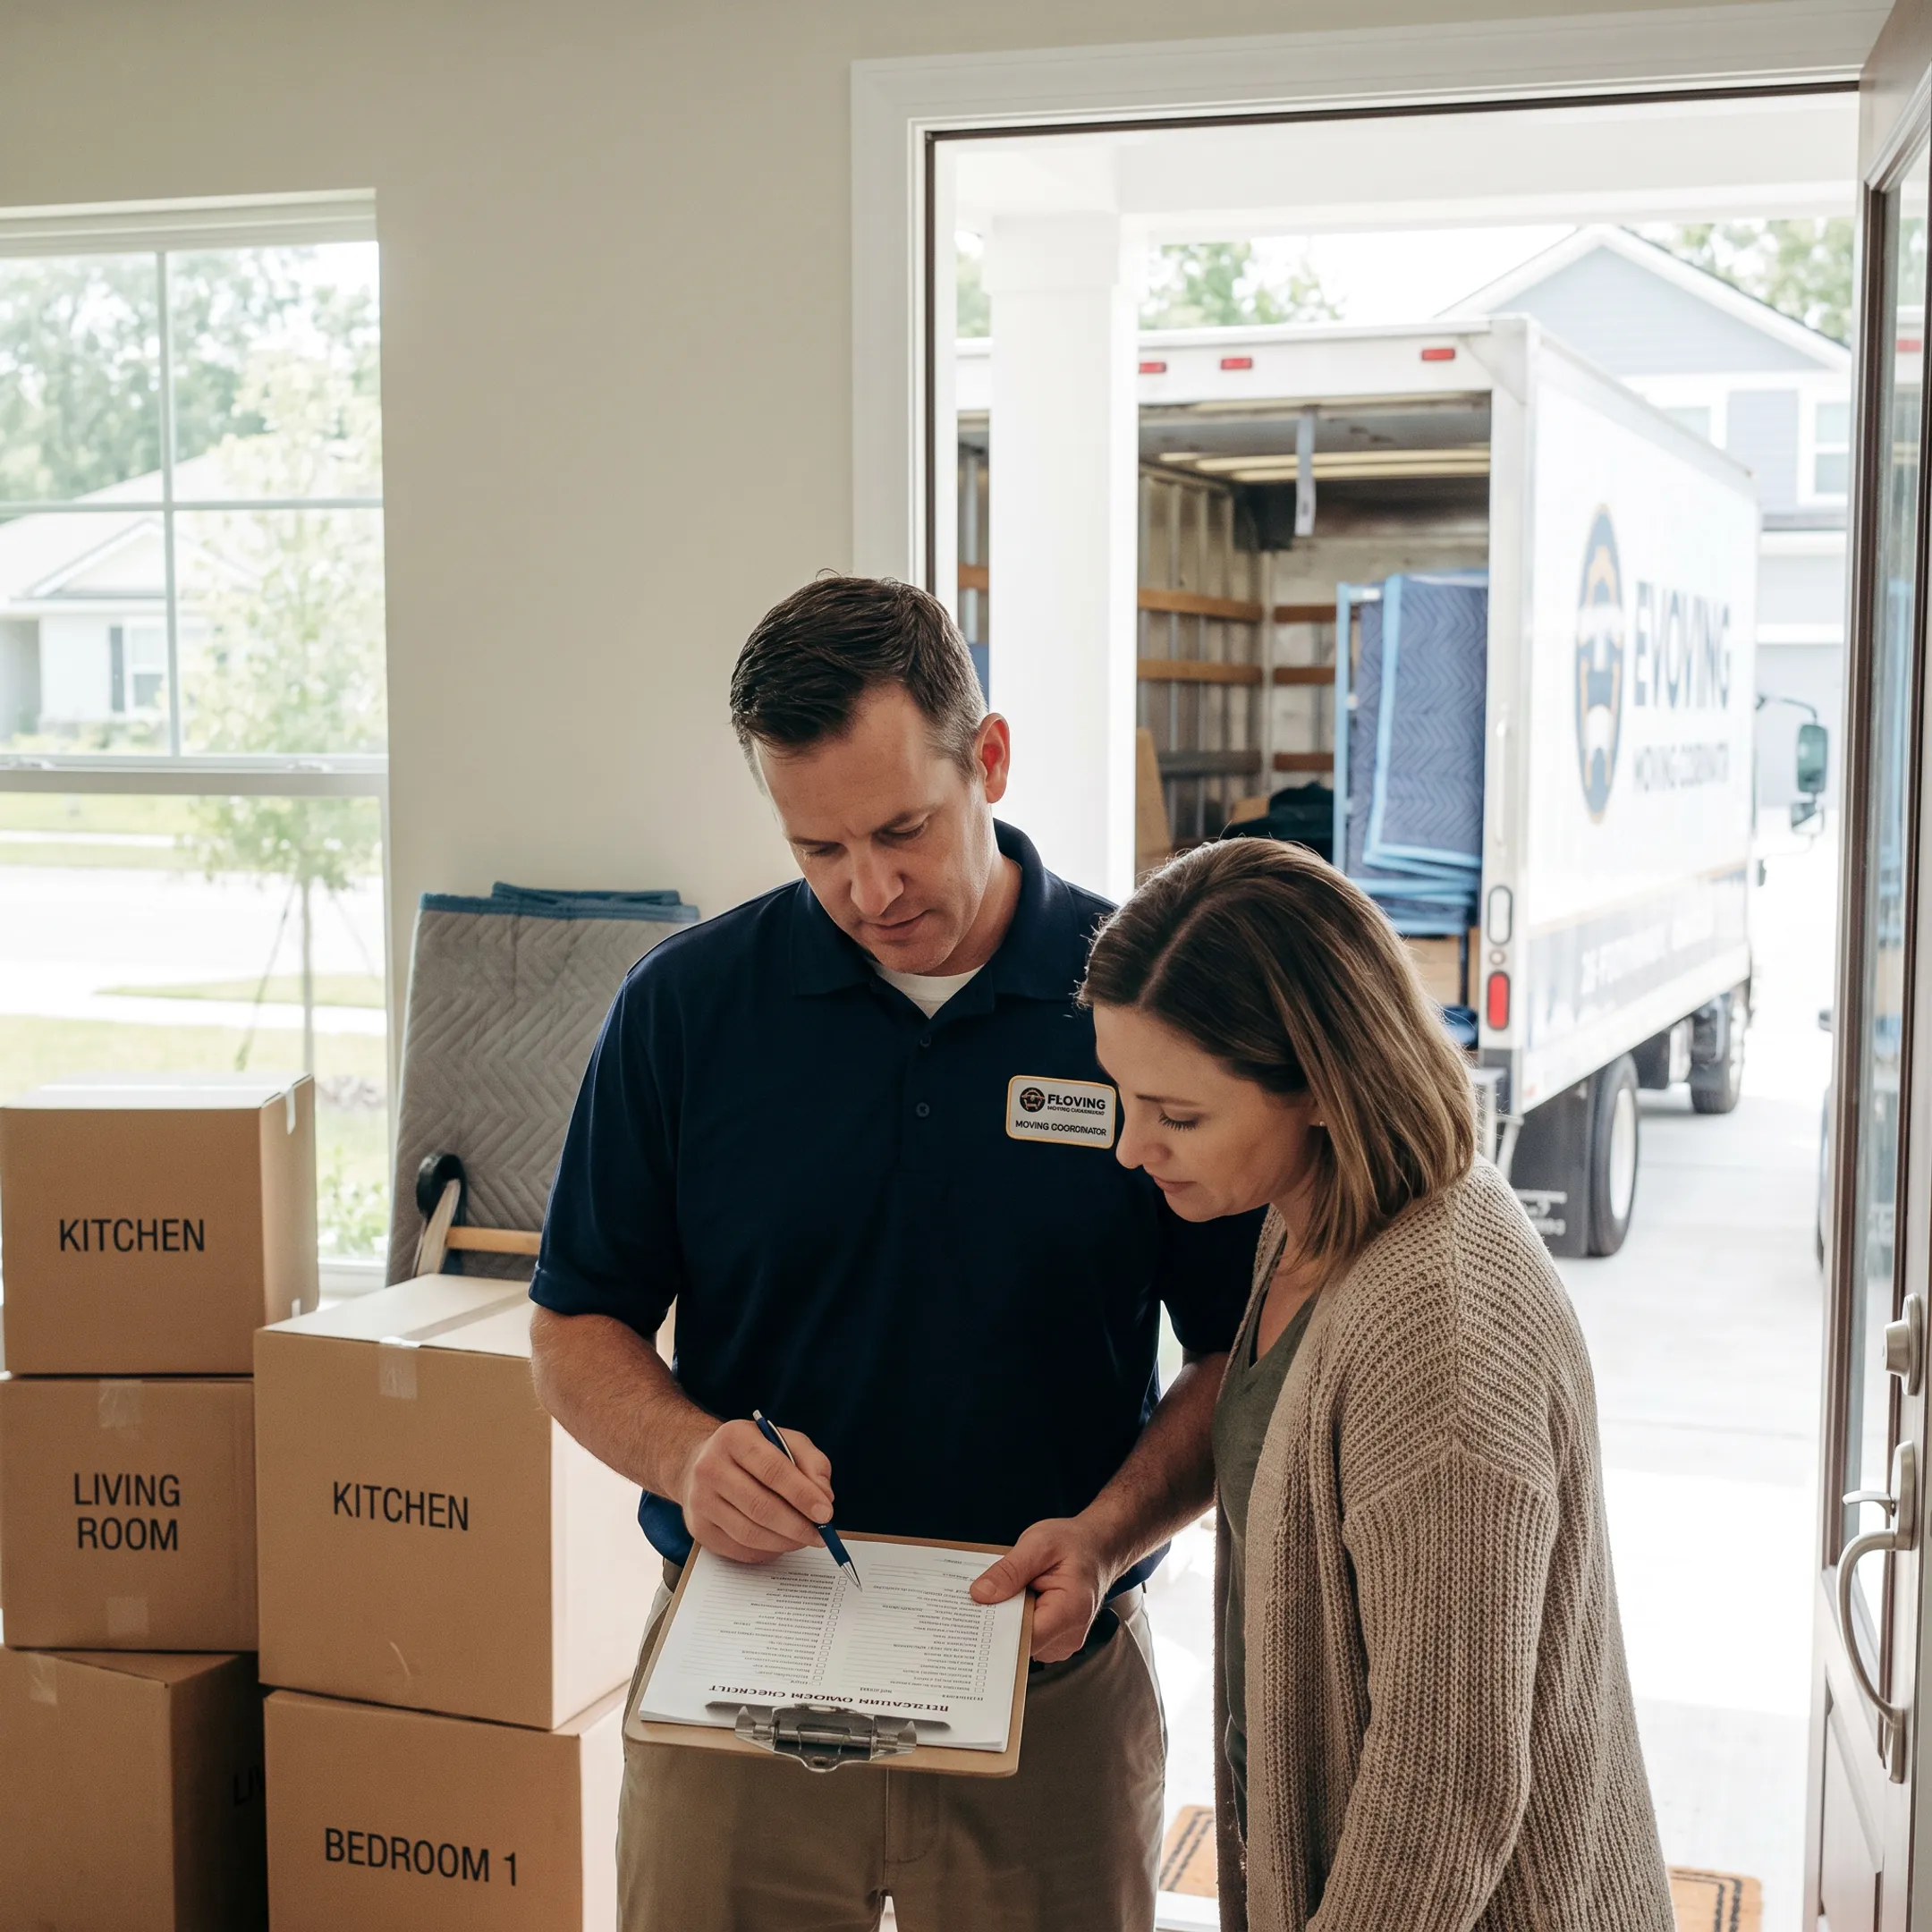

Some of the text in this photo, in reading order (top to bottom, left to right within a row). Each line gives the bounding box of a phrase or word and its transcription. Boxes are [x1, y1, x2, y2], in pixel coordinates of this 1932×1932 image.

[1047, 1094, 1106, 1110] FLOVING
[1015, 1120, 1107, 1136] MOVING COORDINATOR
[60, 1218, 205, 1253] KITCHEN
[74, 1472, 181, 1508] LIVING
[334, 1480, 469, 1531] KITCHEN
[78, 1516, 179, 1552] ROOM
[325, 1827, 516, 1886] BEDROOM 1
